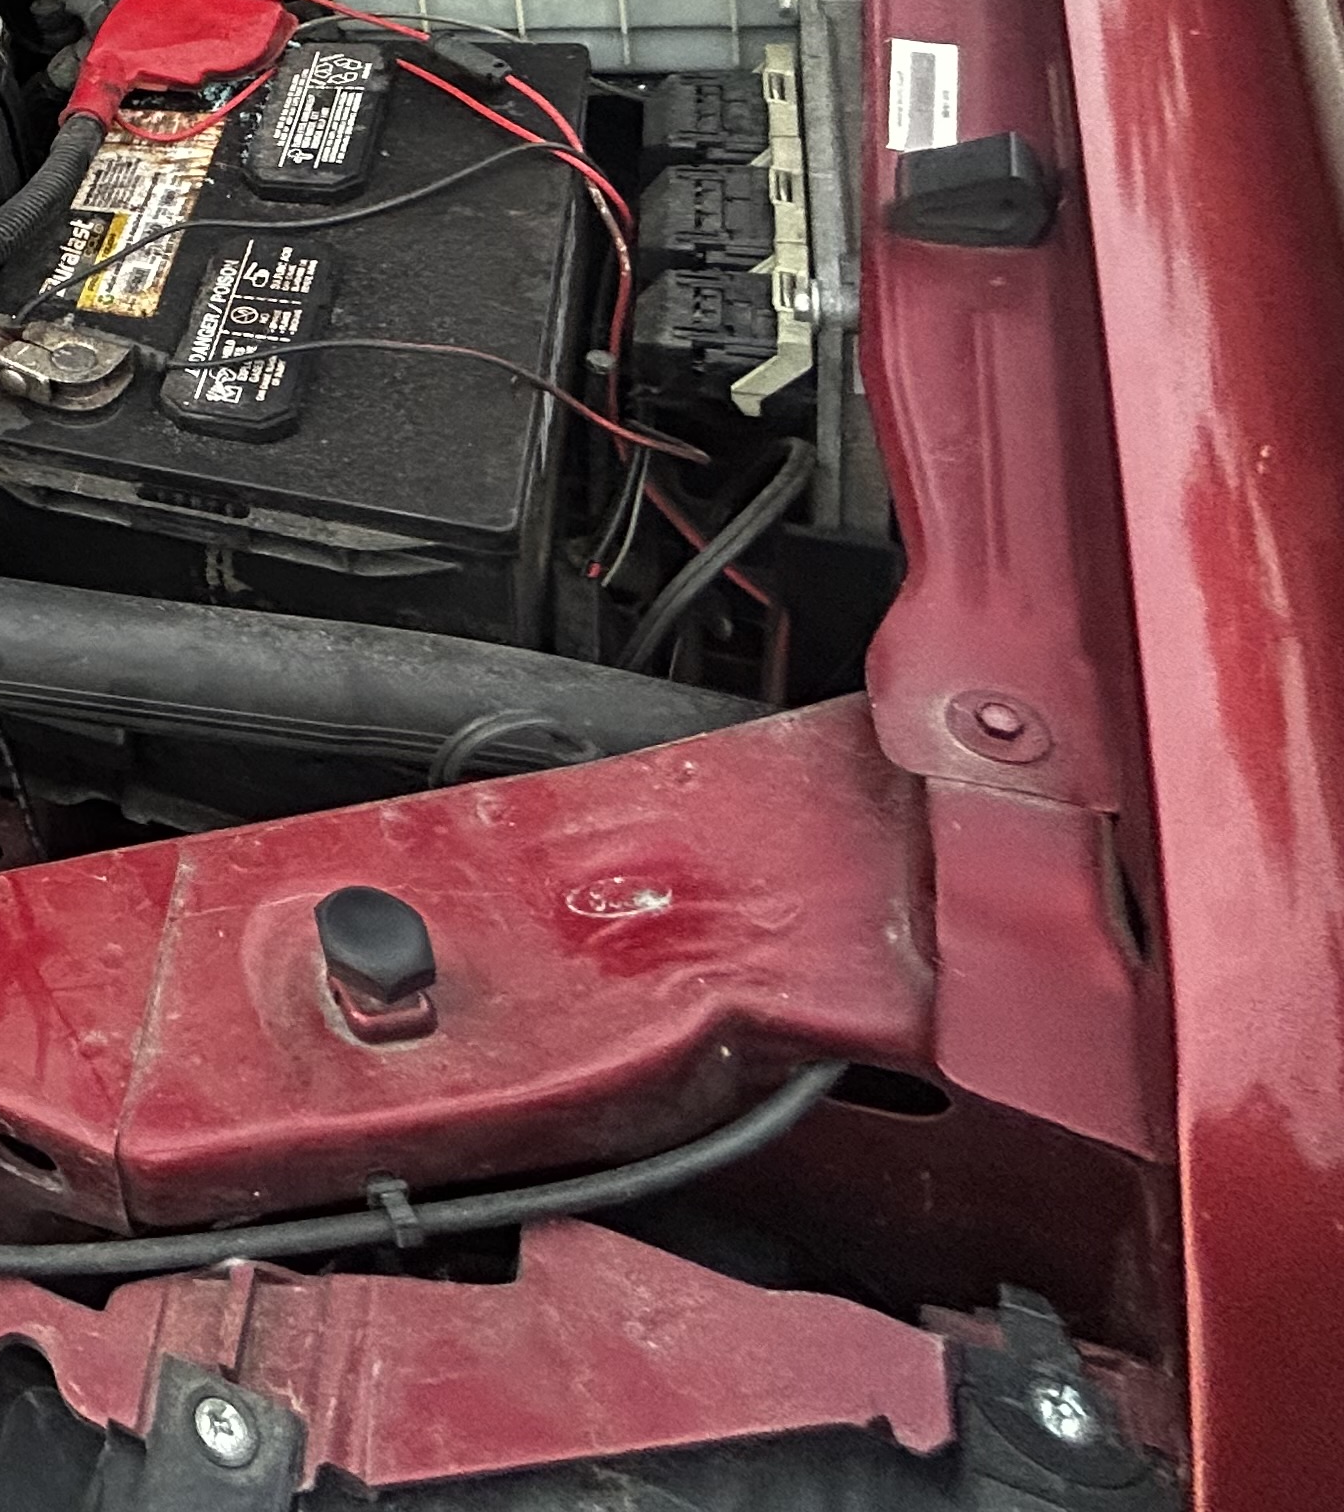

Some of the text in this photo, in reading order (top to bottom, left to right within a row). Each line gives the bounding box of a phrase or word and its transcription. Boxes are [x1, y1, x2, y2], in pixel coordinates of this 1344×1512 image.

[38, 218, 95, 298] Duralast
[188, 259, 240, 363] DANGER / POISON
